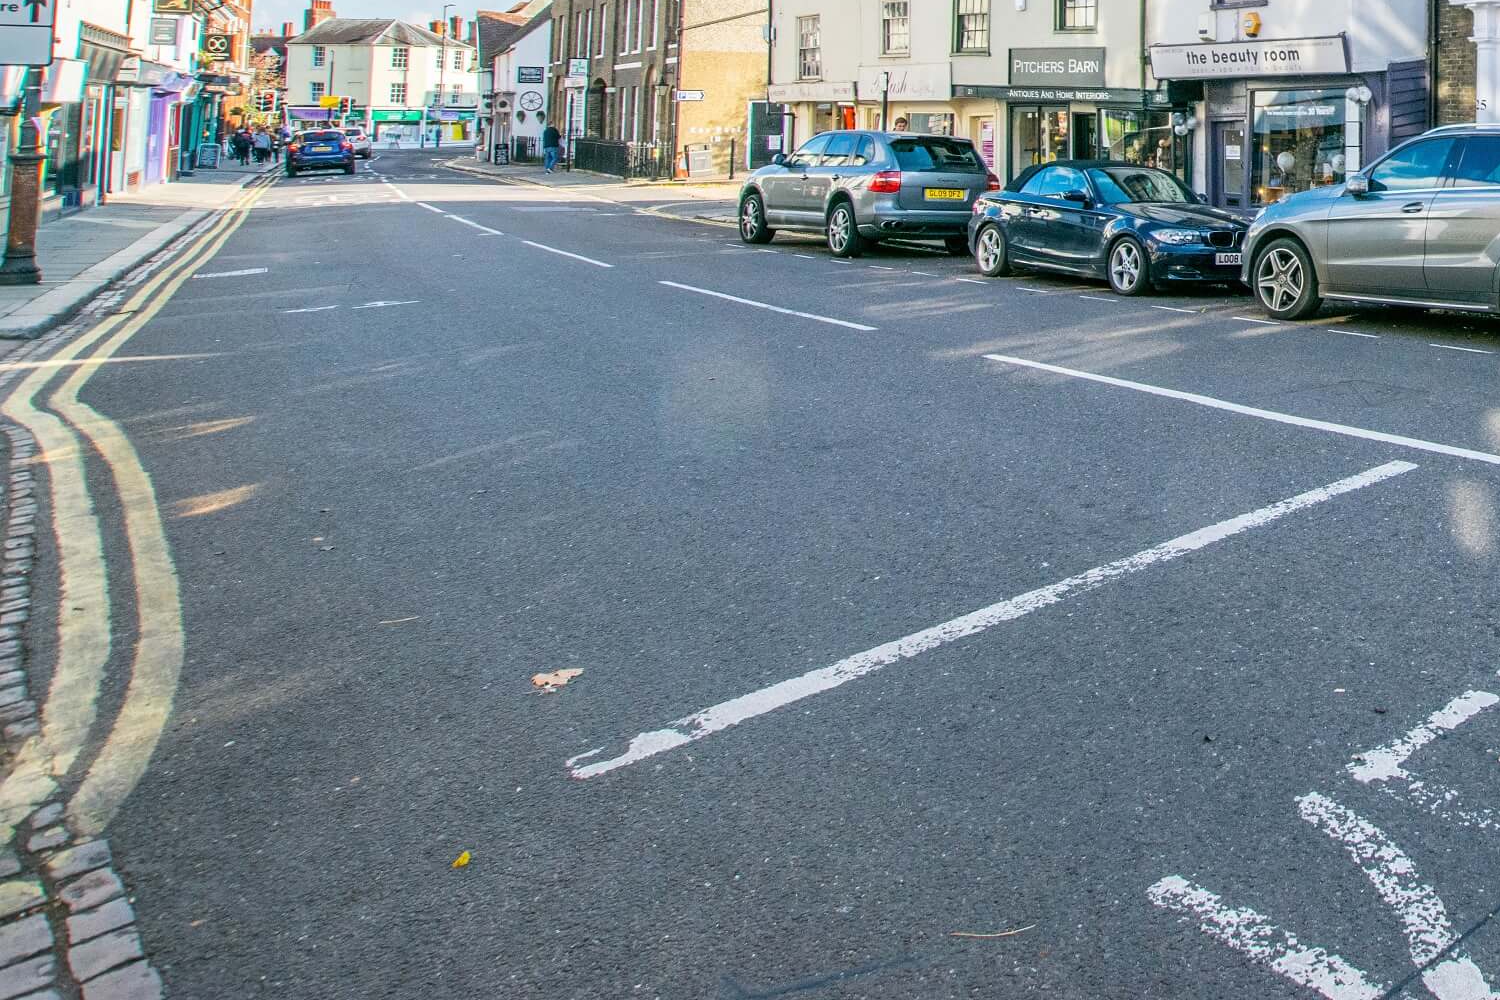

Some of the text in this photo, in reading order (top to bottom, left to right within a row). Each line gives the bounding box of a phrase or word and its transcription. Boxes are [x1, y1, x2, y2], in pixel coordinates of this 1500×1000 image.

[1187, 51, 1207, 65] the
[1212, 48, 1259, 65] beauty
[1264, 49, 1300, 62] room
[1013, 58, 1099, 73] PITCHERS BARN
[1040, 90, 1055, 99] AND
[1056, 90, 1075, 99] HOME
